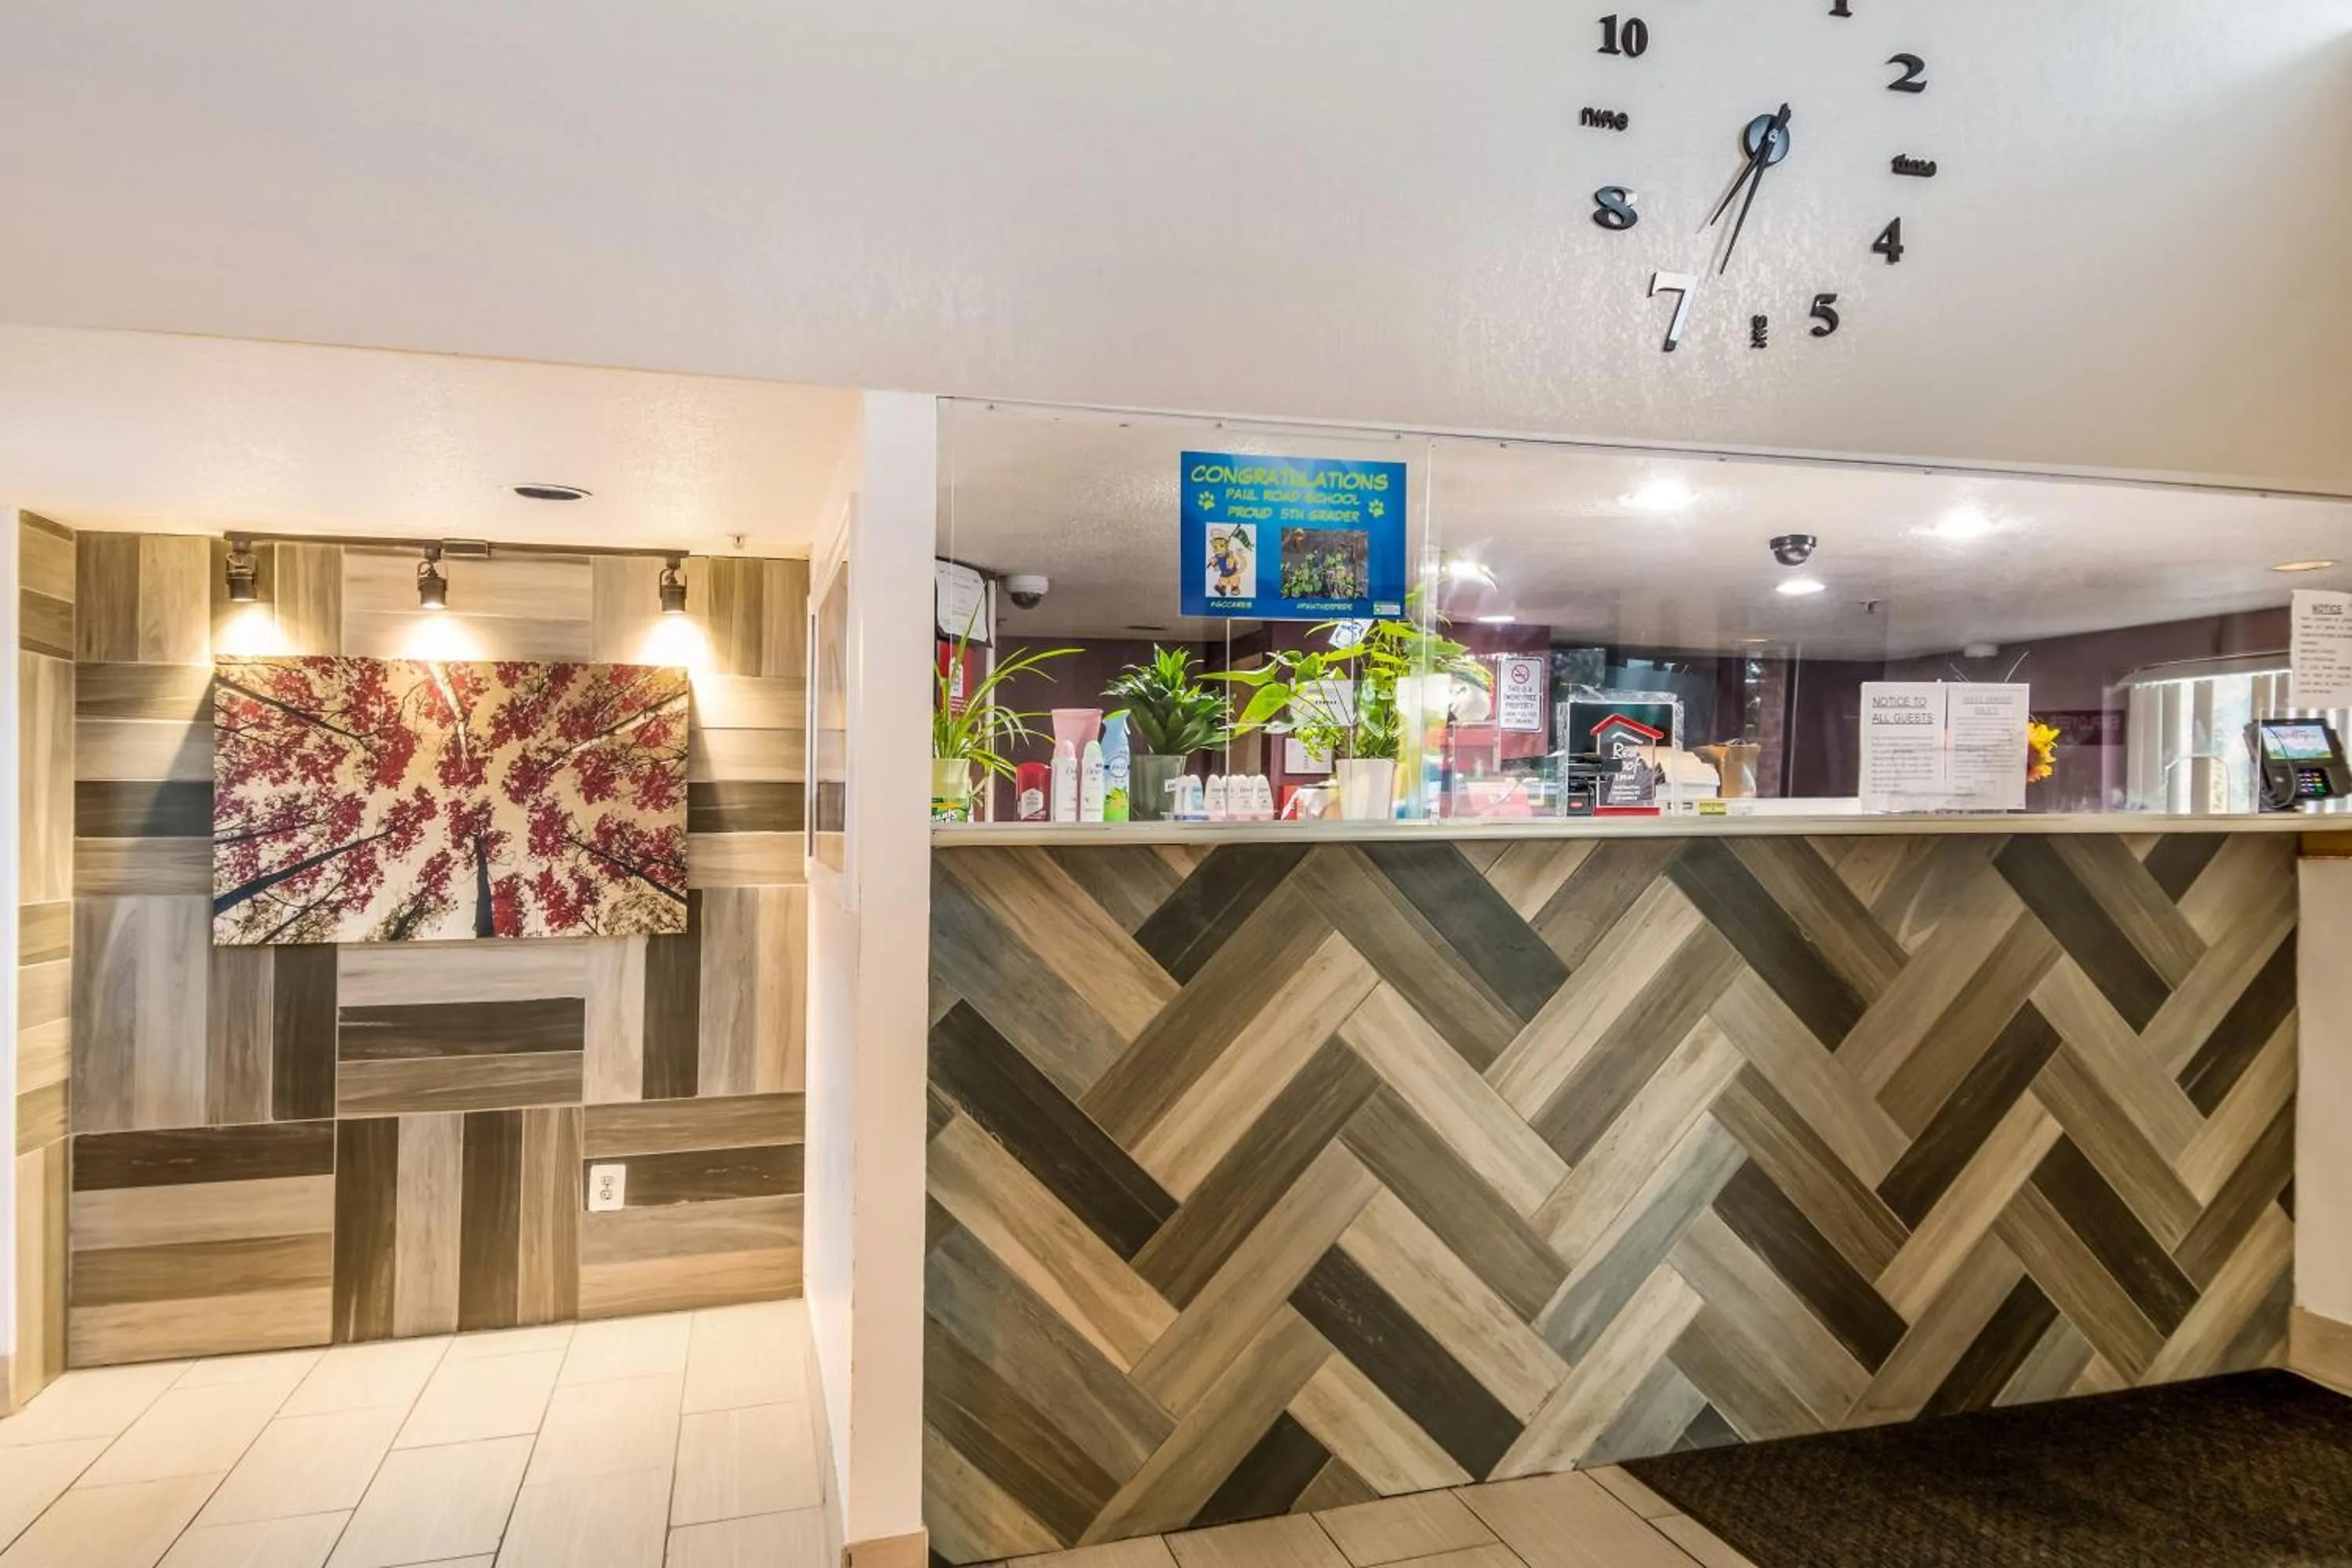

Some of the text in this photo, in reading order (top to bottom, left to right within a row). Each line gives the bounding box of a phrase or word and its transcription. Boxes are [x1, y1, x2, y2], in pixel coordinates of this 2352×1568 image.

[1598, 14, 1648, 57] 10
[1886, 53, 1927, 93] 2
[1580, 107, 1628, 131] nine
[1593, 186, 1638, 230] 8
[1871, 216, 1904, 264] 4
[1647, 272, 1697, 352] 7
[1809, 293, 1839, 336] 5
[1191, 464, 1389, 492] CONGRATULATIONS
[1225, 488, 1361, 506] PAUL ROAD SCHOOL
[1227, 506, 1360, 522] PROUD 5TH GRADER
[2313, 604, 2343, 615] NOTICE
[1872, 696, 1928, 708] NOTICE TO
[1872, 713, 1934, 724] ALL GUESTS
